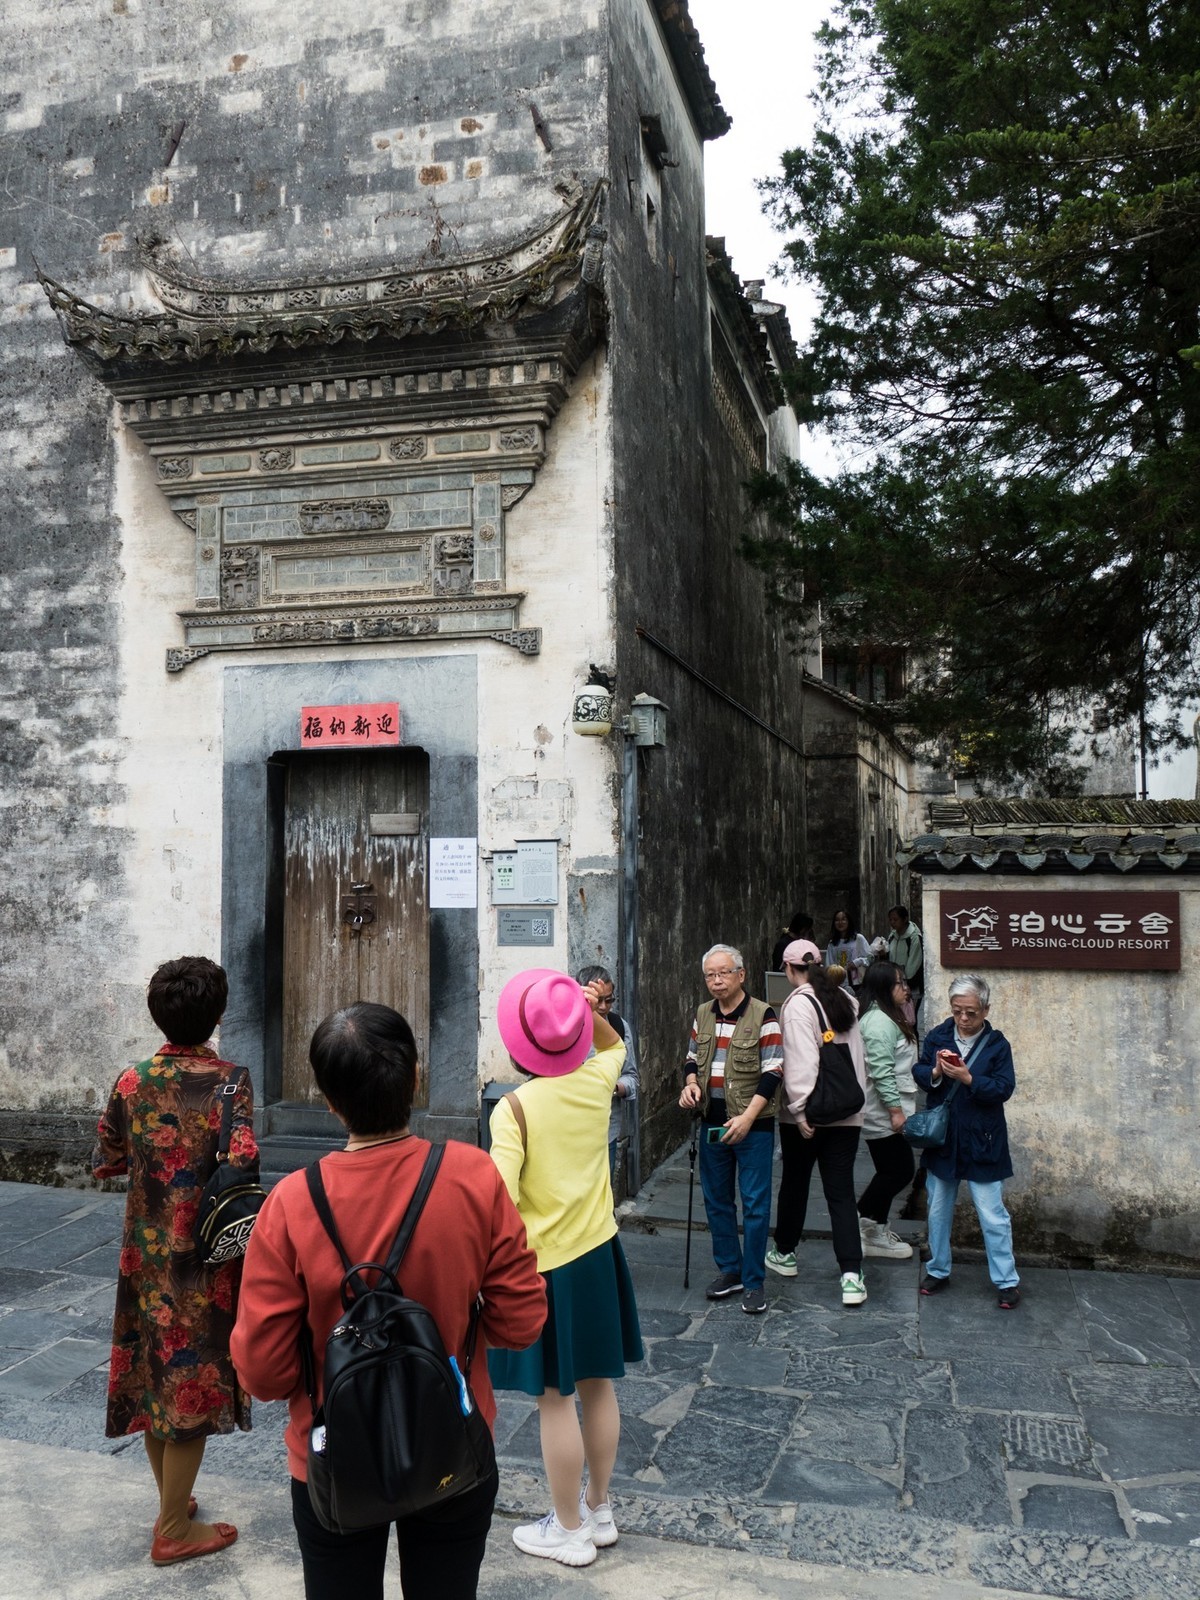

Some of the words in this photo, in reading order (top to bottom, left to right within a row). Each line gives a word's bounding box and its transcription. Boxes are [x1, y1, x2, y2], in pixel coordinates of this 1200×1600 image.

[1008, 910, 1174, 935] 泊心云舍
[1011, 937, 1114, 949] PASSING-CLOUD
[1118, 938, 1171, 950] RESORT
